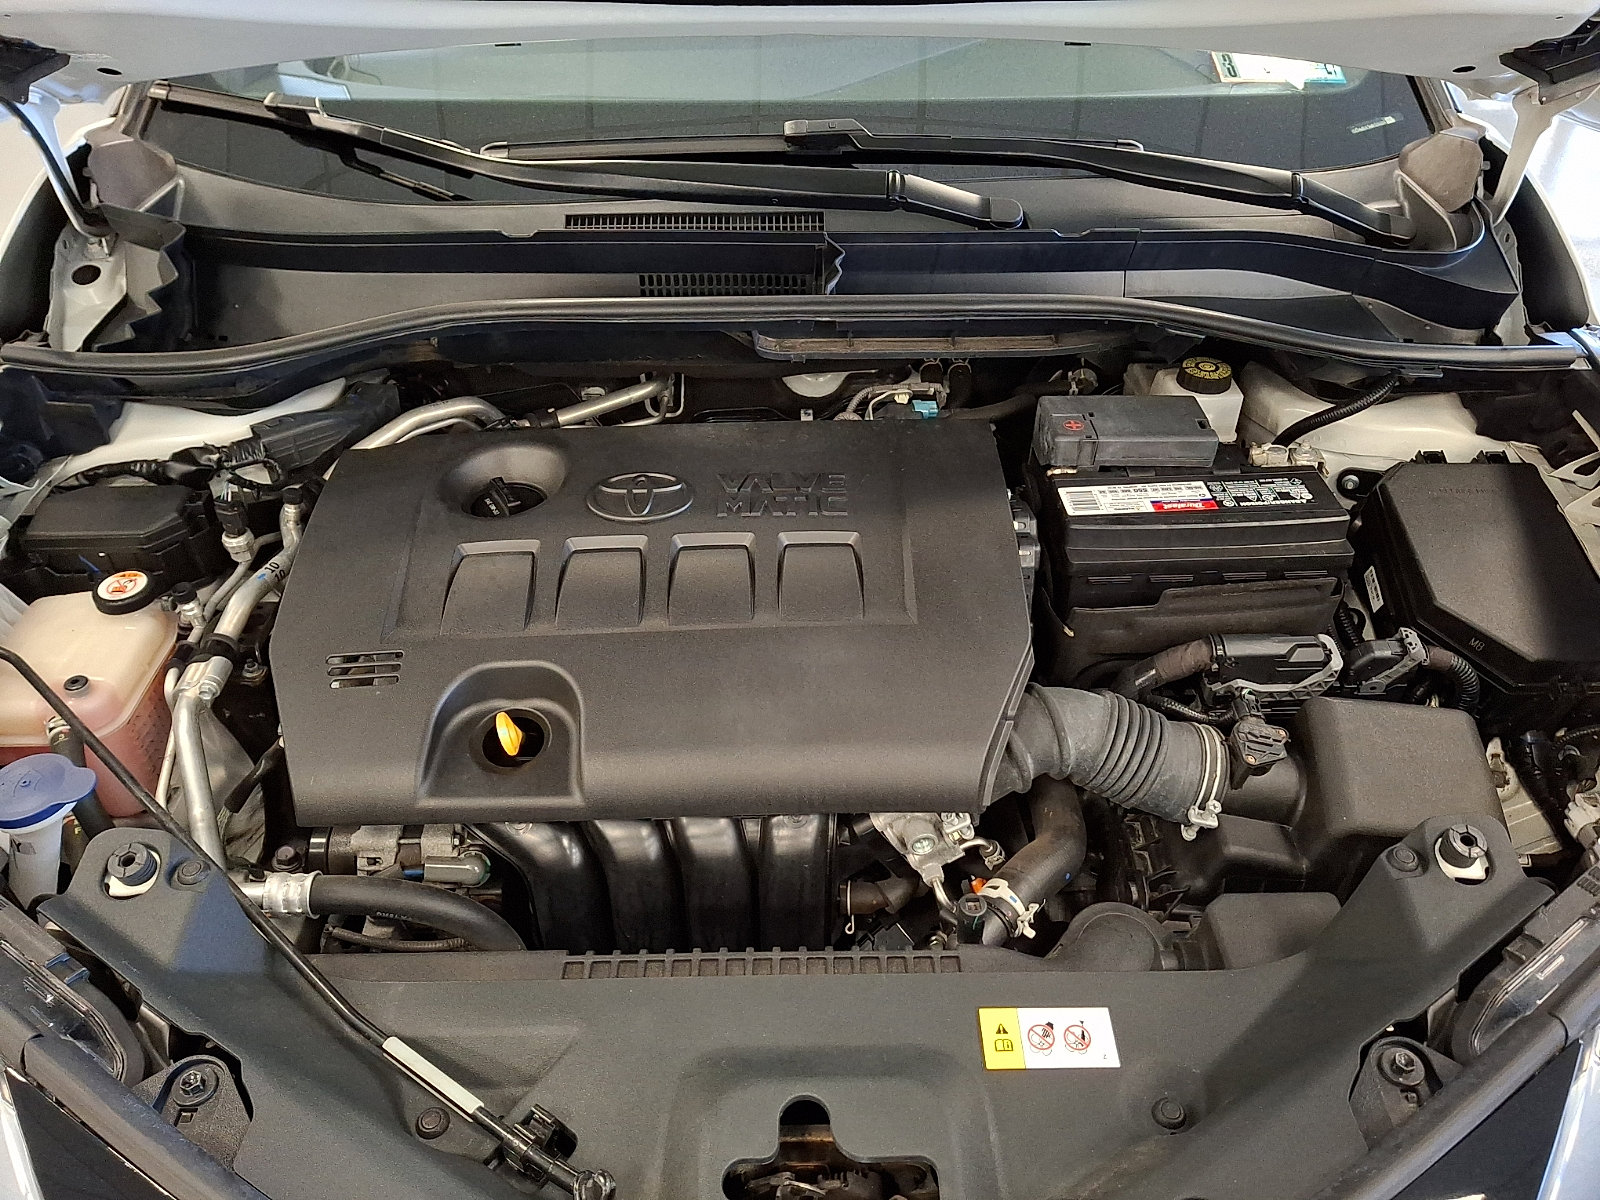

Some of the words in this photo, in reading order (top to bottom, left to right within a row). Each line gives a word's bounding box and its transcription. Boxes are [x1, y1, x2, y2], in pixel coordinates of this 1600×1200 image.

[716, 472, 847, 494] VALVE
[715, 496, 848, 517] MATIC
[1162, 502, 1206, 510] Duralast
[264, 561, 280, 574] 10
[1468, 636, 1486, 652] M8
